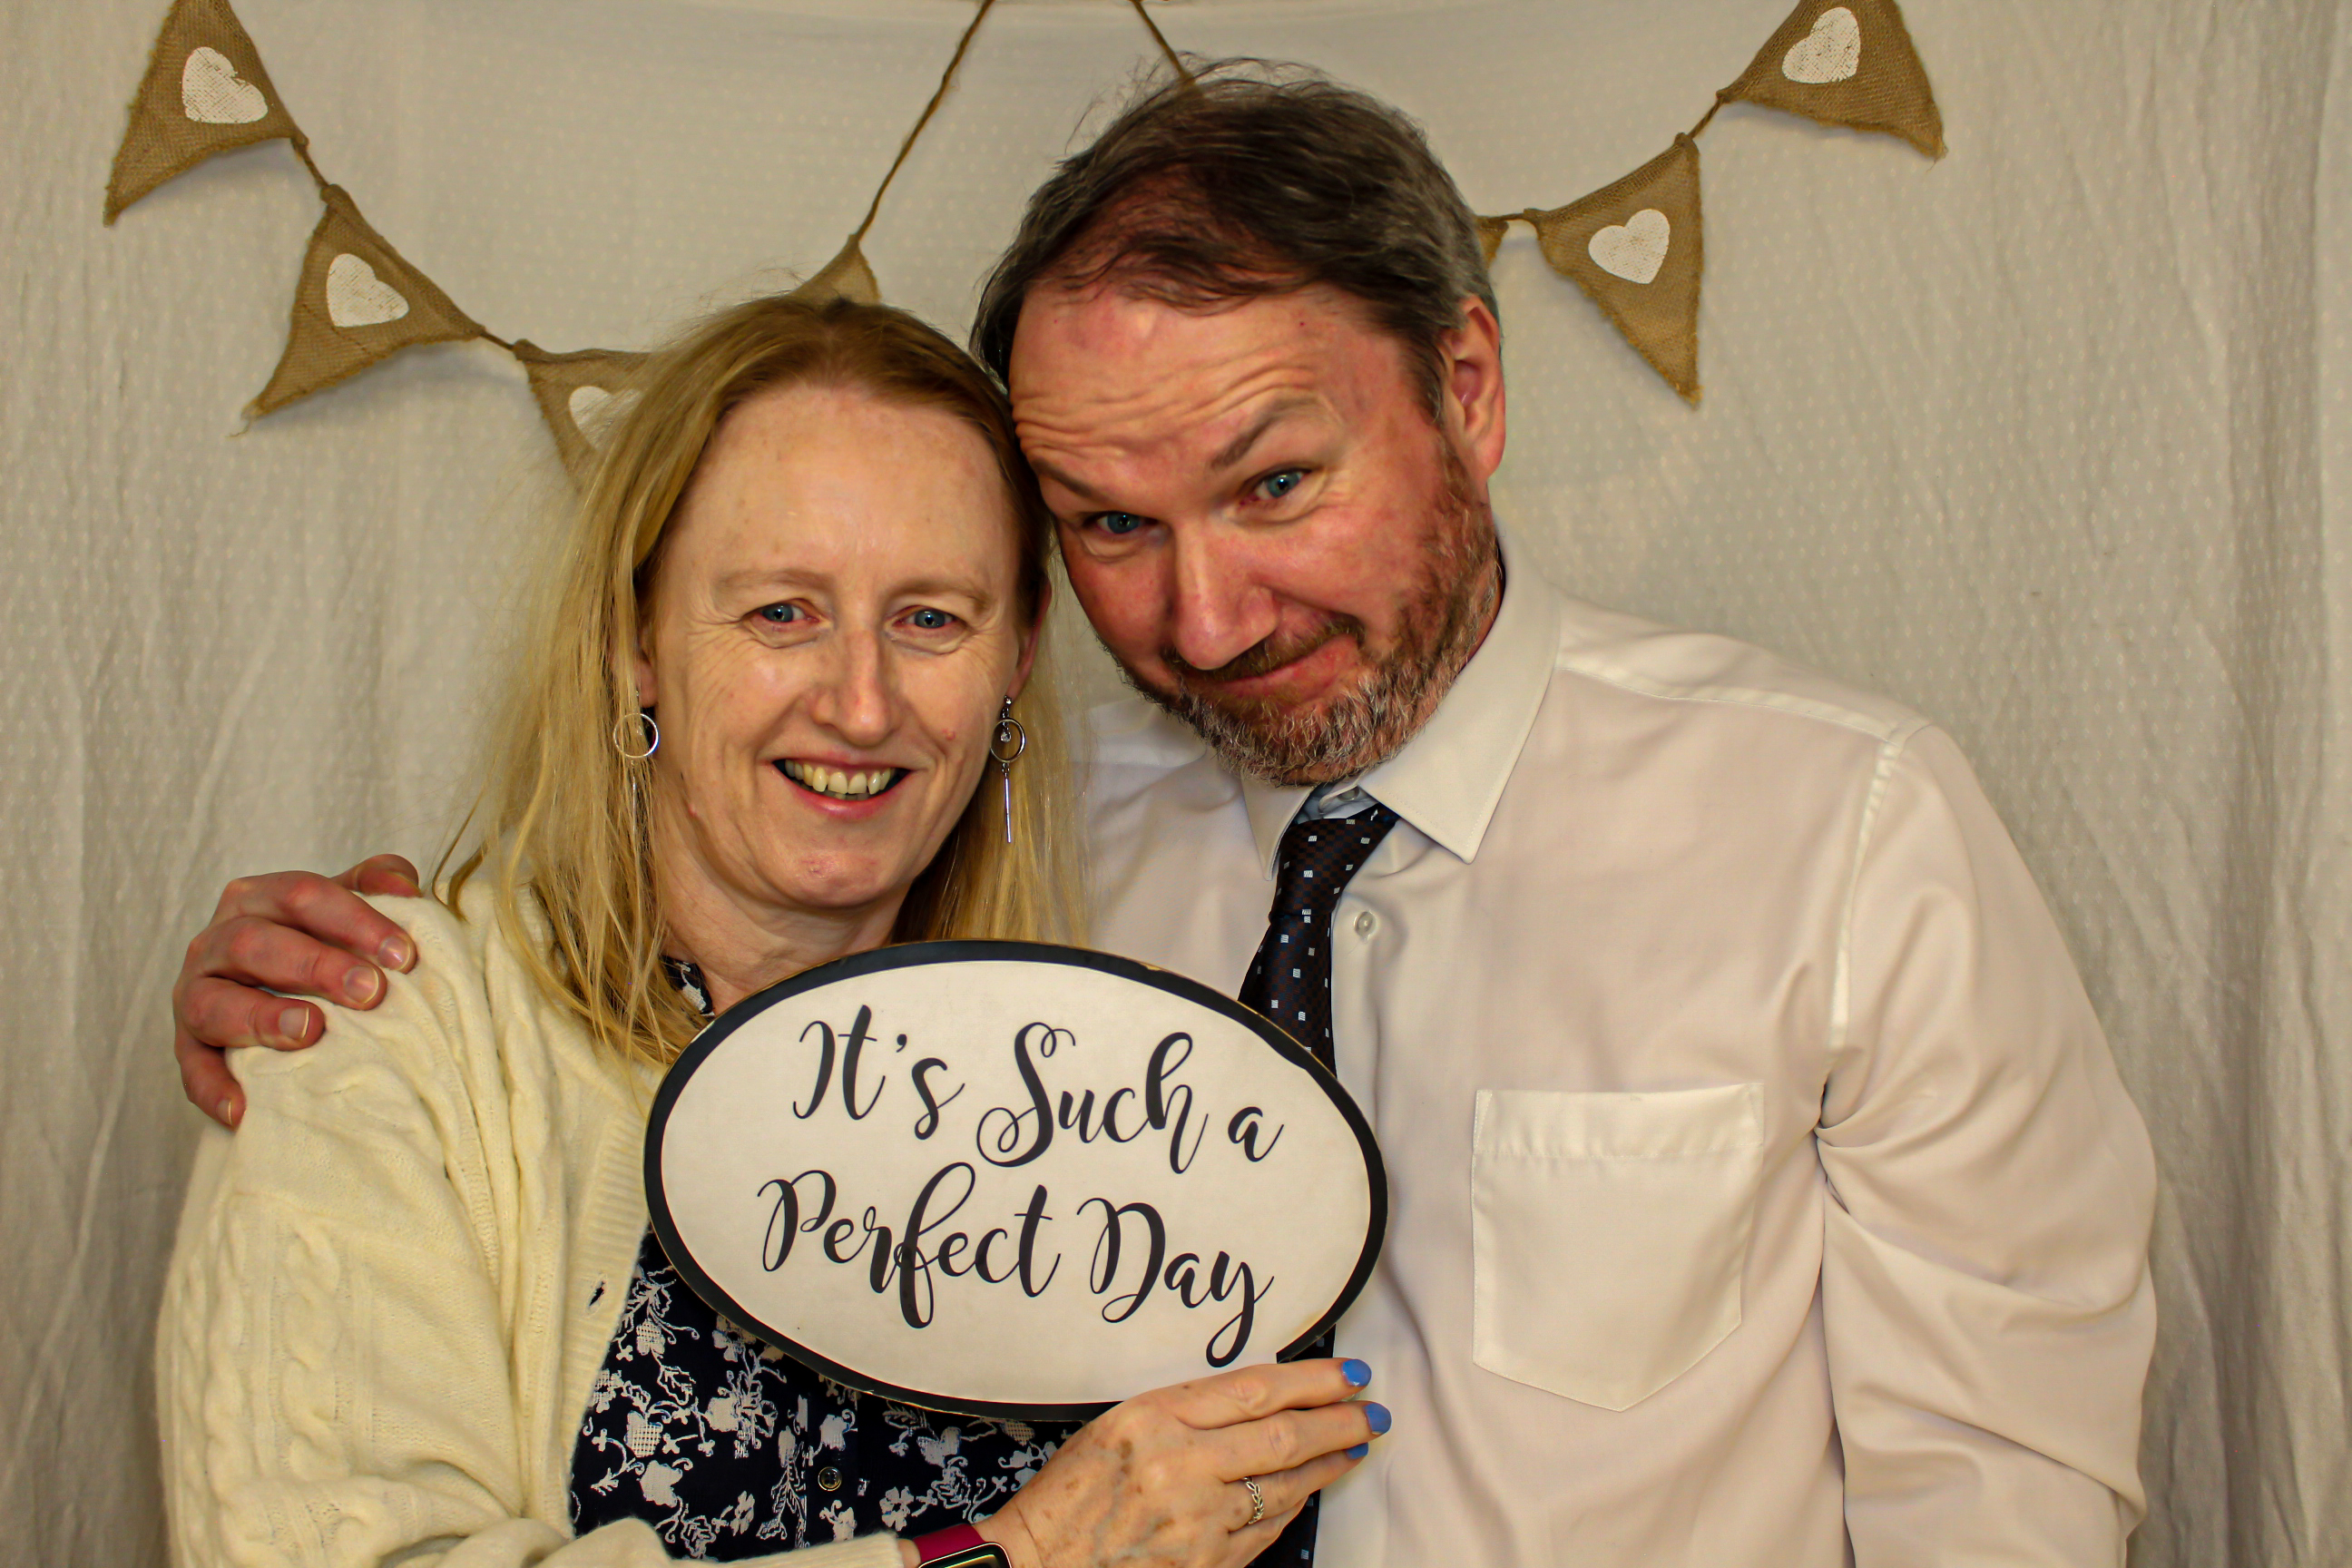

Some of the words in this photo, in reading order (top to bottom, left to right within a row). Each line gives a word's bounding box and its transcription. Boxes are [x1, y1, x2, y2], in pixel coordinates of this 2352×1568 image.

[792, 1004, 965, 1141] It's
[975, 1022, 1209, 1175] Such
[1227, 1106, 1285, 1162] a
[757, 1161, 1062, 1329] Perfect
[1076, 1197, 1275, 1368] Day
